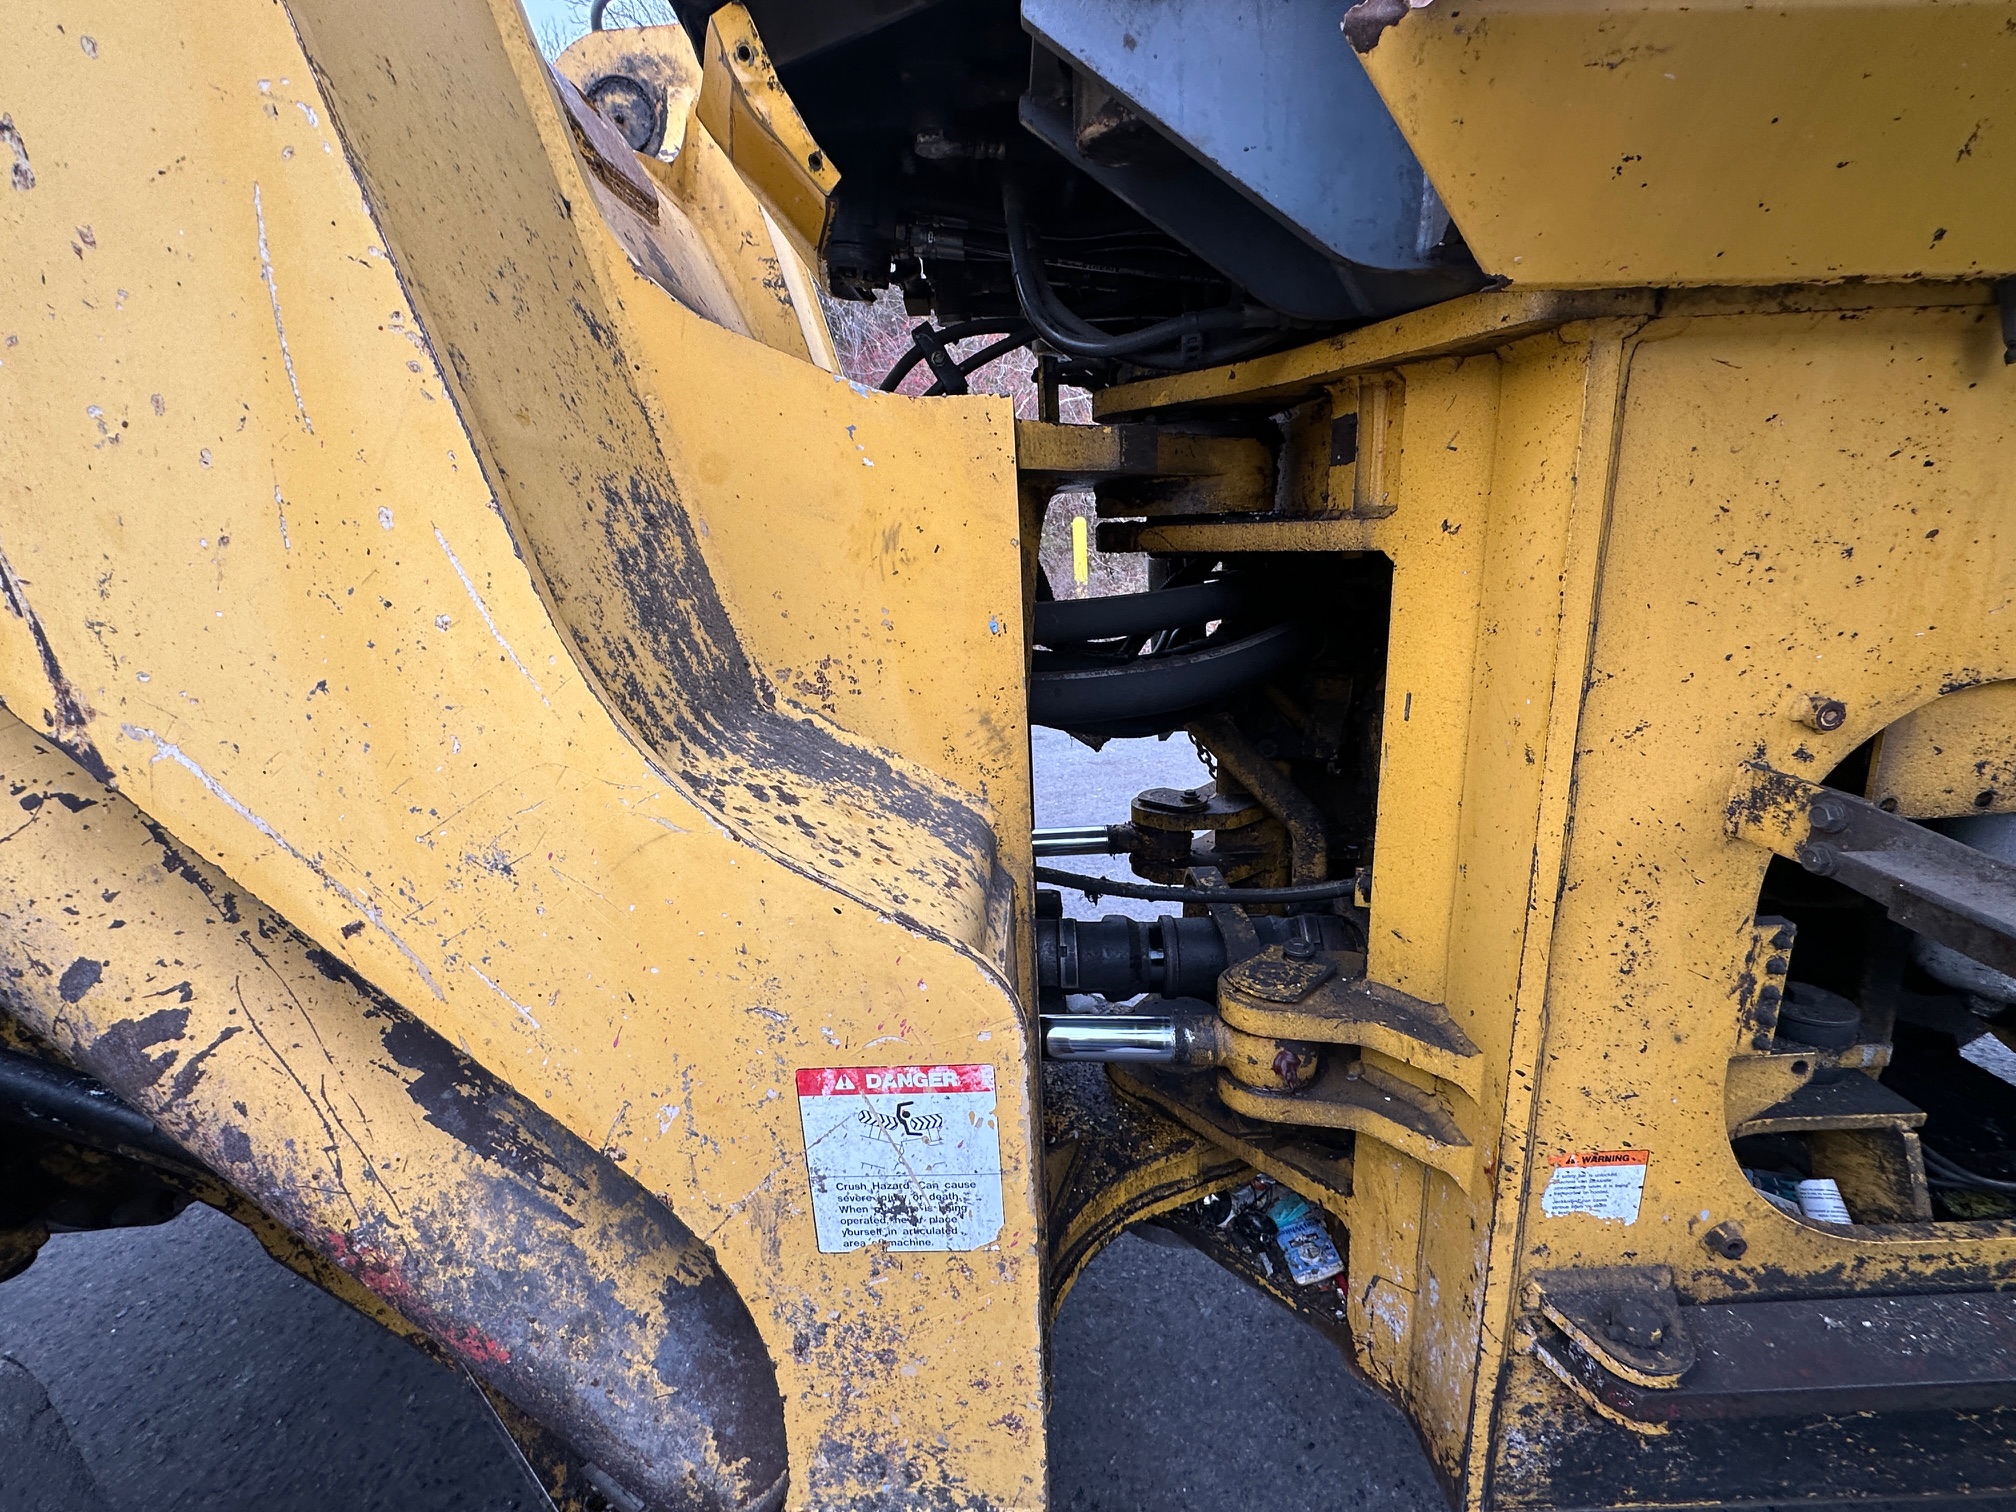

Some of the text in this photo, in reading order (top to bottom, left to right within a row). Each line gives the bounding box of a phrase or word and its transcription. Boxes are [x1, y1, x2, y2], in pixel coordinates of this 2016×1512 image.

[865, 1073, 959, 1089] DANGER
[1581, 1154, 1630, 1164] WARNING
[835, 1182, 867, 1191] Crush
[918, 1181, 939, 1190] Can
[944, 1181, 977, 1189] cause
[837, 1194, 873, 1202] severe
[876, 1193, 907, 1203] njuy
[912, 1193, 924, 1201] or
[838, 1204, 869, 1214] When
[924, 1204, 933, 1212] is
[893, 1216, 924, 1225] ner
[929, 1216, 958, 1226] place
[841, 1226, 958, 1238] yourself in articulated
[843, 1239, 866, 1248] area
[889, 1238, 934, 1248] machine.
